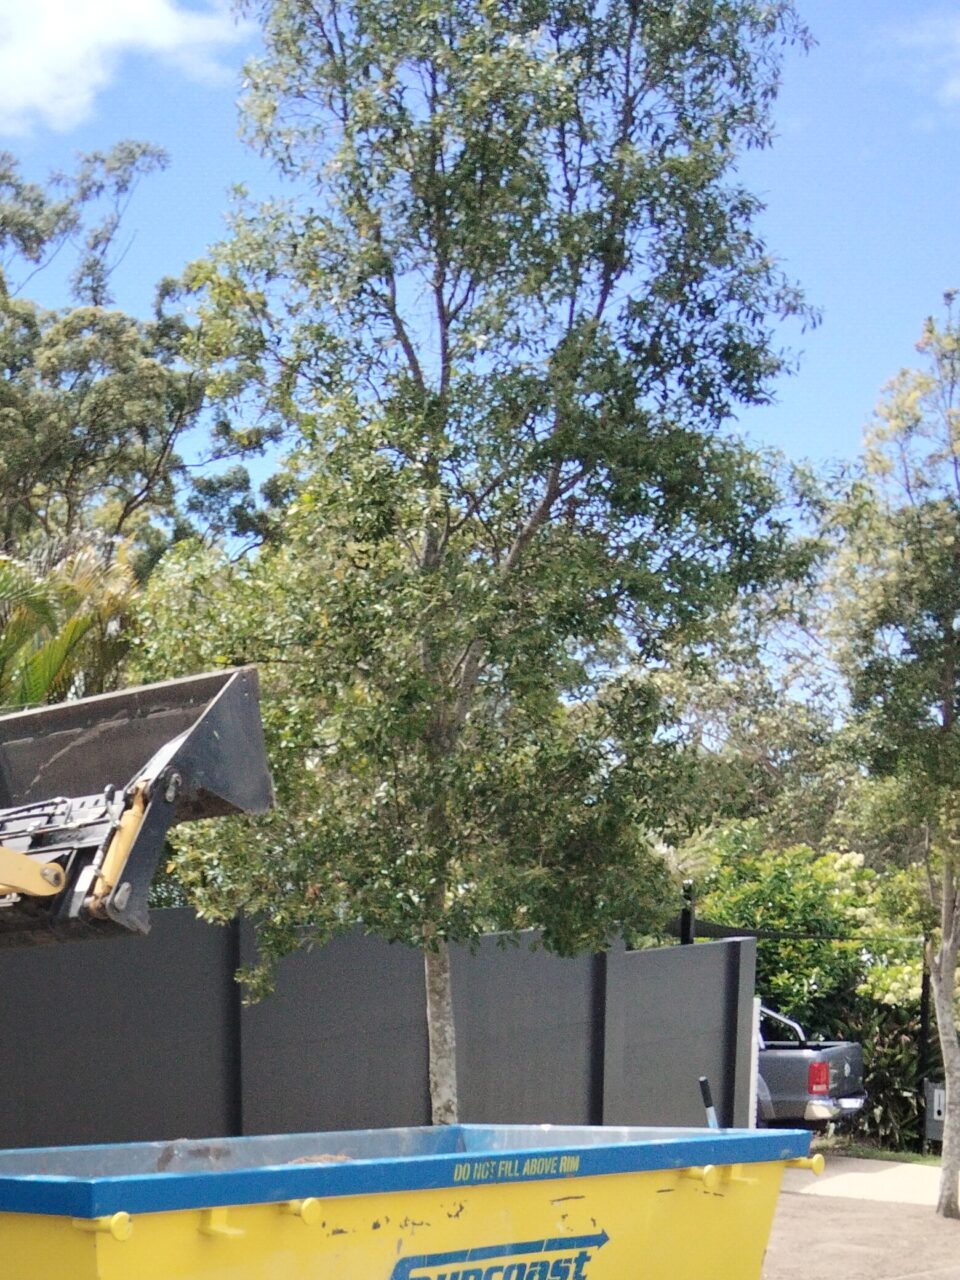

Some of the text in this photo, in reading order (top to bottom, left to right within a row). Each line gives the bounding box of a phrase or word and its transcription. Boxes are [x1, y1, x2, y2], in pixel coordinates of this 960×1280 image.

[453, 1163, 470, 1181] DO
[498, 1160, 519, 1177] FILL
[523, 1156, 557, 1176] ABOVE
[559, 1155, 580, 1173] RIM
